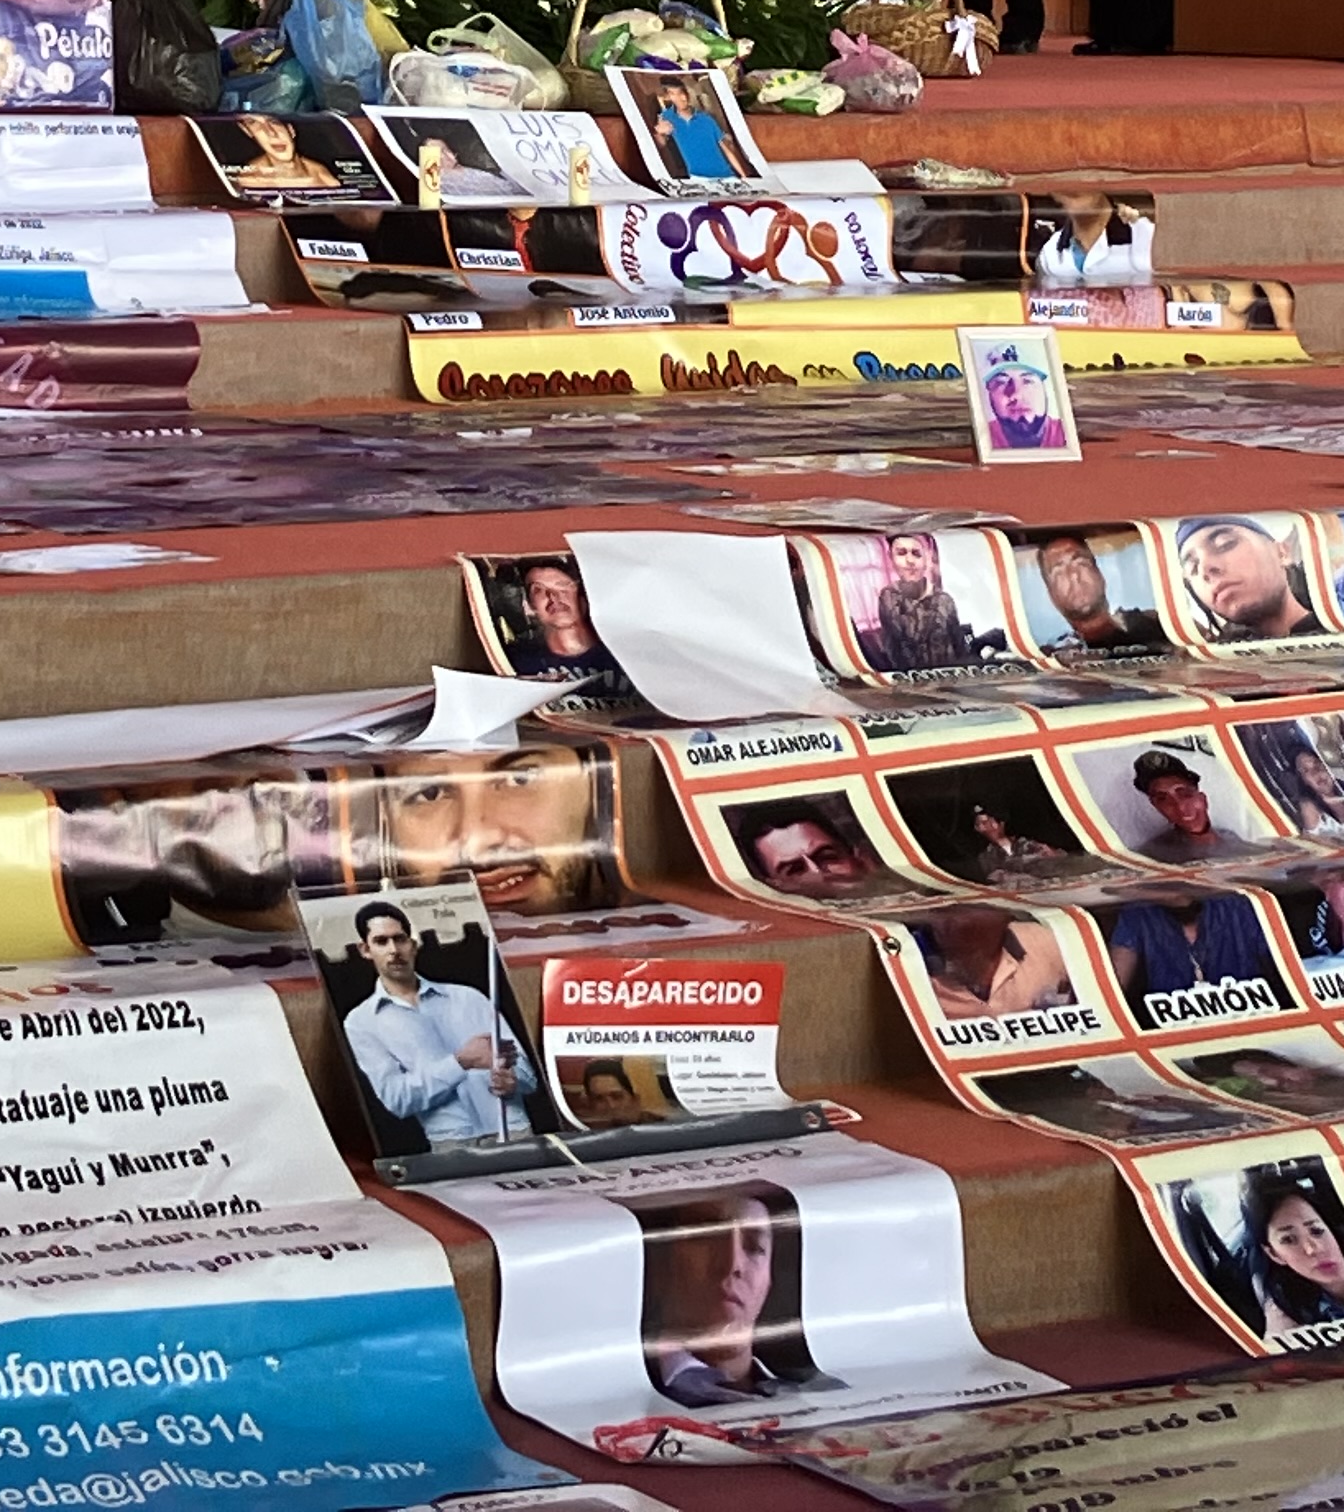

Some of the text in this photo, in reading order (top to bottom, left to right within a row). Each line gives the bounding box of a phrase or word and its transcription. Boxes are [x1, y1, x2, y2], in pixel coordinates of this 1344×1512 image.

[34, 21, 113, 60] Pétalo
[307, 241, 358, 258] Fabián
[459, 250, 522, 267] Christian
[422, 311, 469, 327] Pedro
[577, 303, 670, 322] José Antonio
[1029, 299, 1090, 319] Alejandro
[1177, 306, 1212, 323] Aarón
[686, 732, 833, 766] OMAR ALEJANDRO
[562, 979, 764, 1010] DESAPARECIDO
[1153, 977, 1274, 1024] RAMÓN
[20, 1007, 83, 1040] Abril
[88, 1005, 129, 1034] del
[129, 998, 206, 1036] 2022,
[936, 1008, 1102, 1046] LUIS FELIPE
[566, 1027, 756, 1045] AYÚDANOS A ENCONTRARLO
[94, 1086, 145, 1114] una
[147, 1076, 230, 1118] pluma
[87, 1161, 107, 1187] y
[37, 1418, 149, 1457] 3145
[155, 1411, 264, 1450] 6314
